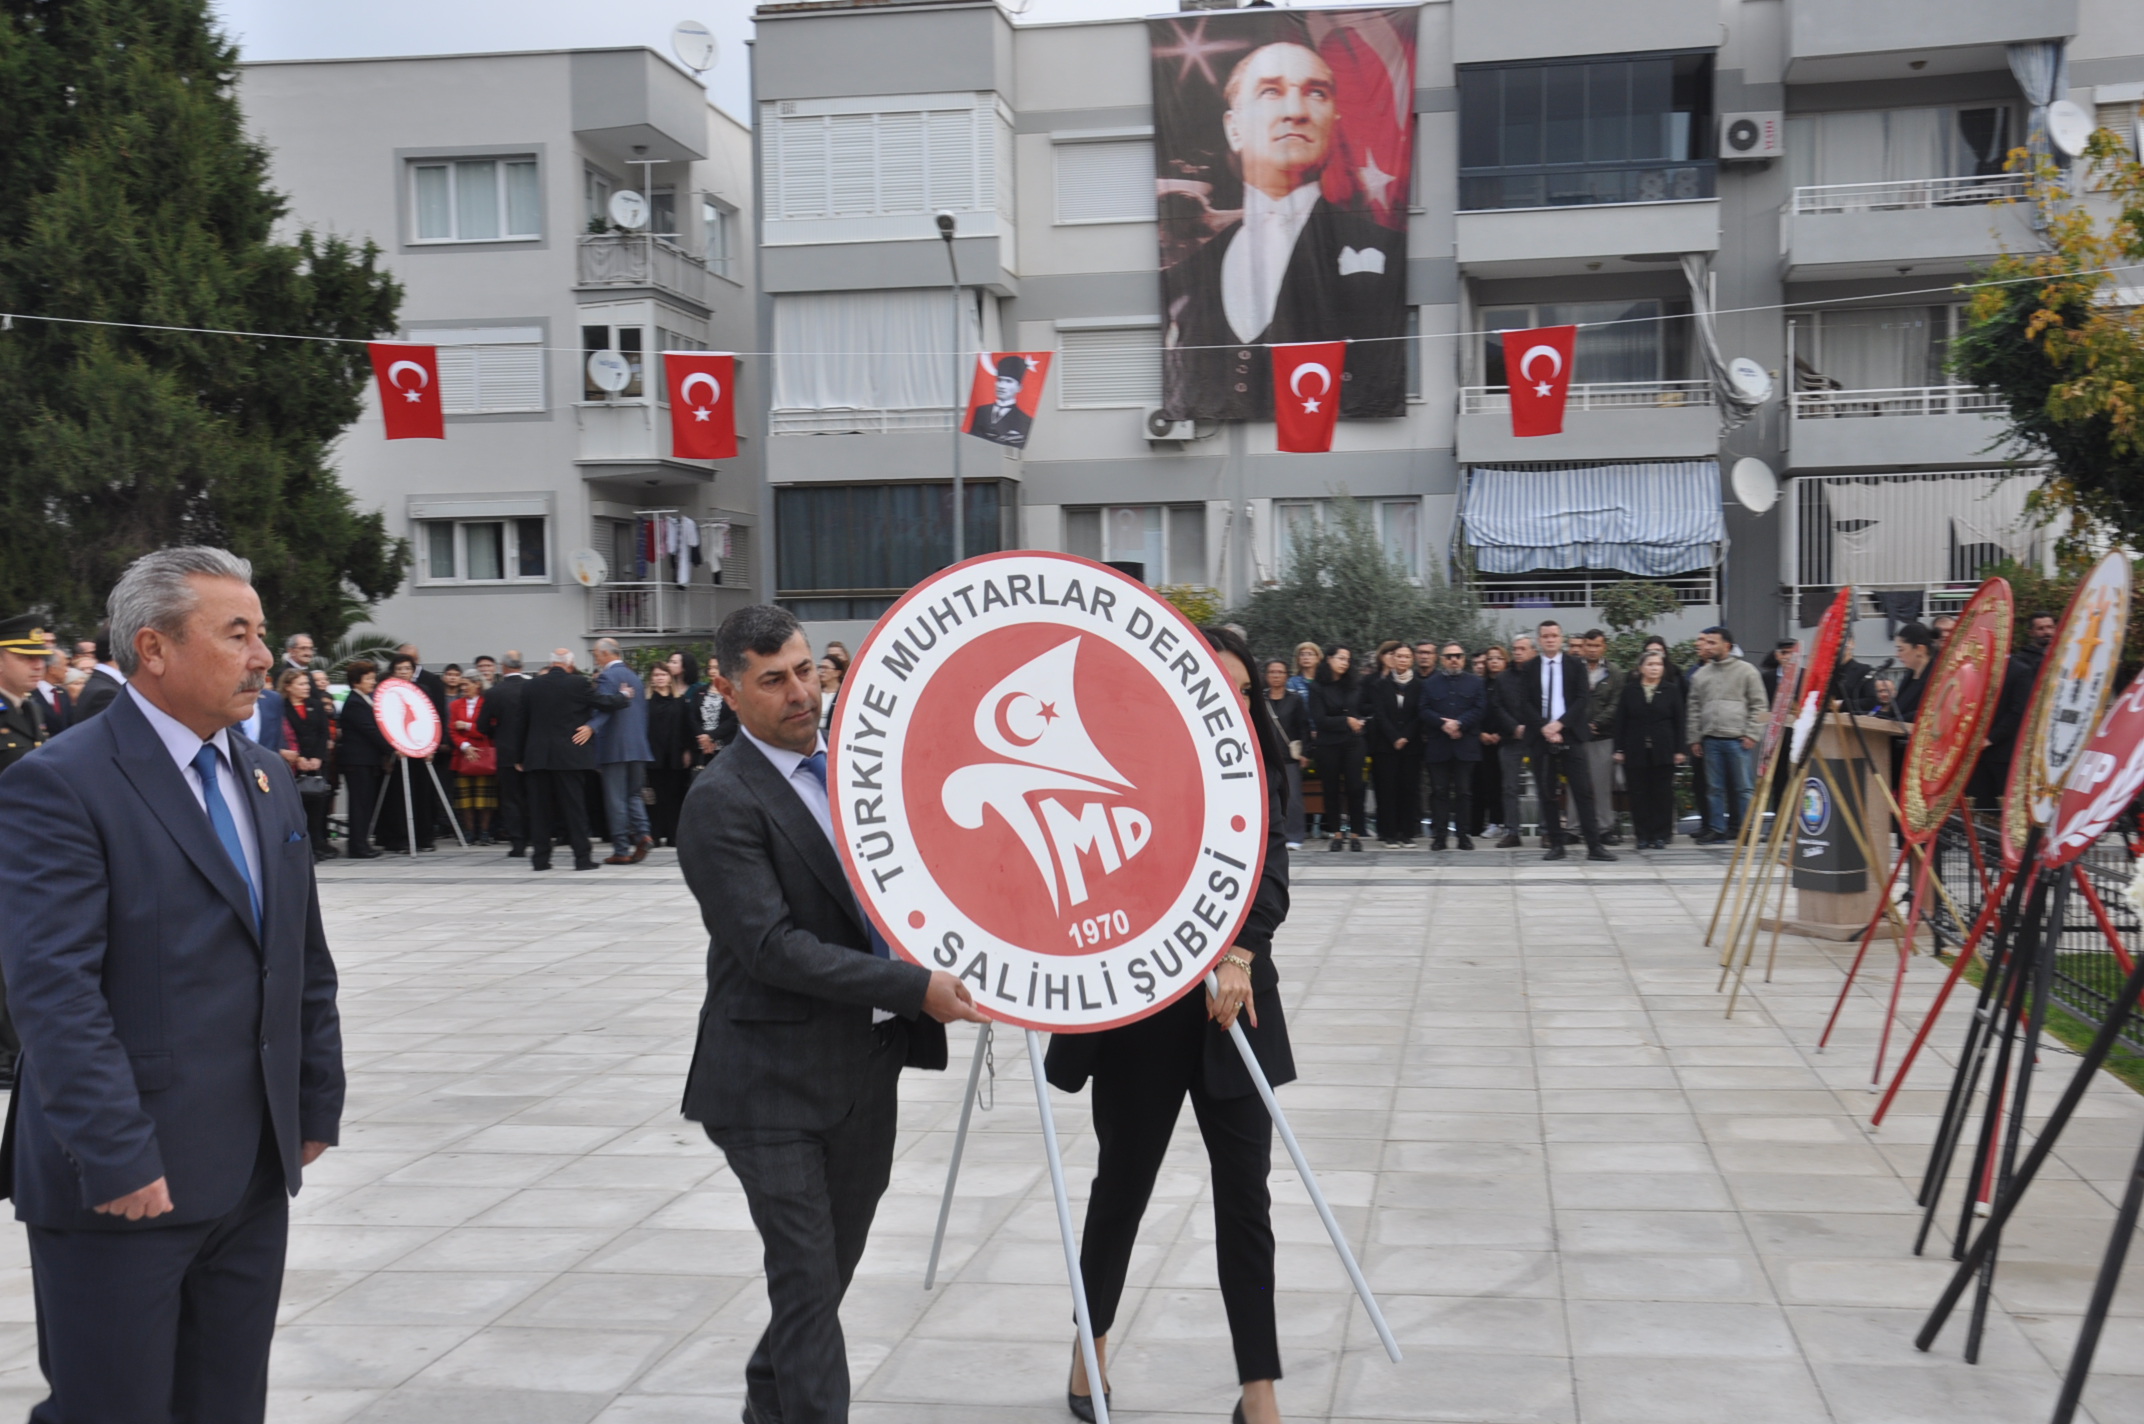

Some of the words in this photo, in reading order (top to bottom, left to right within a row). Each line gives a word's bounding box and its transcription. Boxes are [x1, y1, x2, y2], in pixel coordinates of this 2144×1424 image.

[846, 685, 904, 893] TÜRKİYE
[882, 574, 1116, 682] MUHTARLAR
[1125, 607, 1254, 780] DERNEĞİ
[933, 931, 1118, 1011] SALİHLİ
[1127, 847, 1247, 1003] ŞUBESİ
[1069, 909, 1130, 949] 1970
